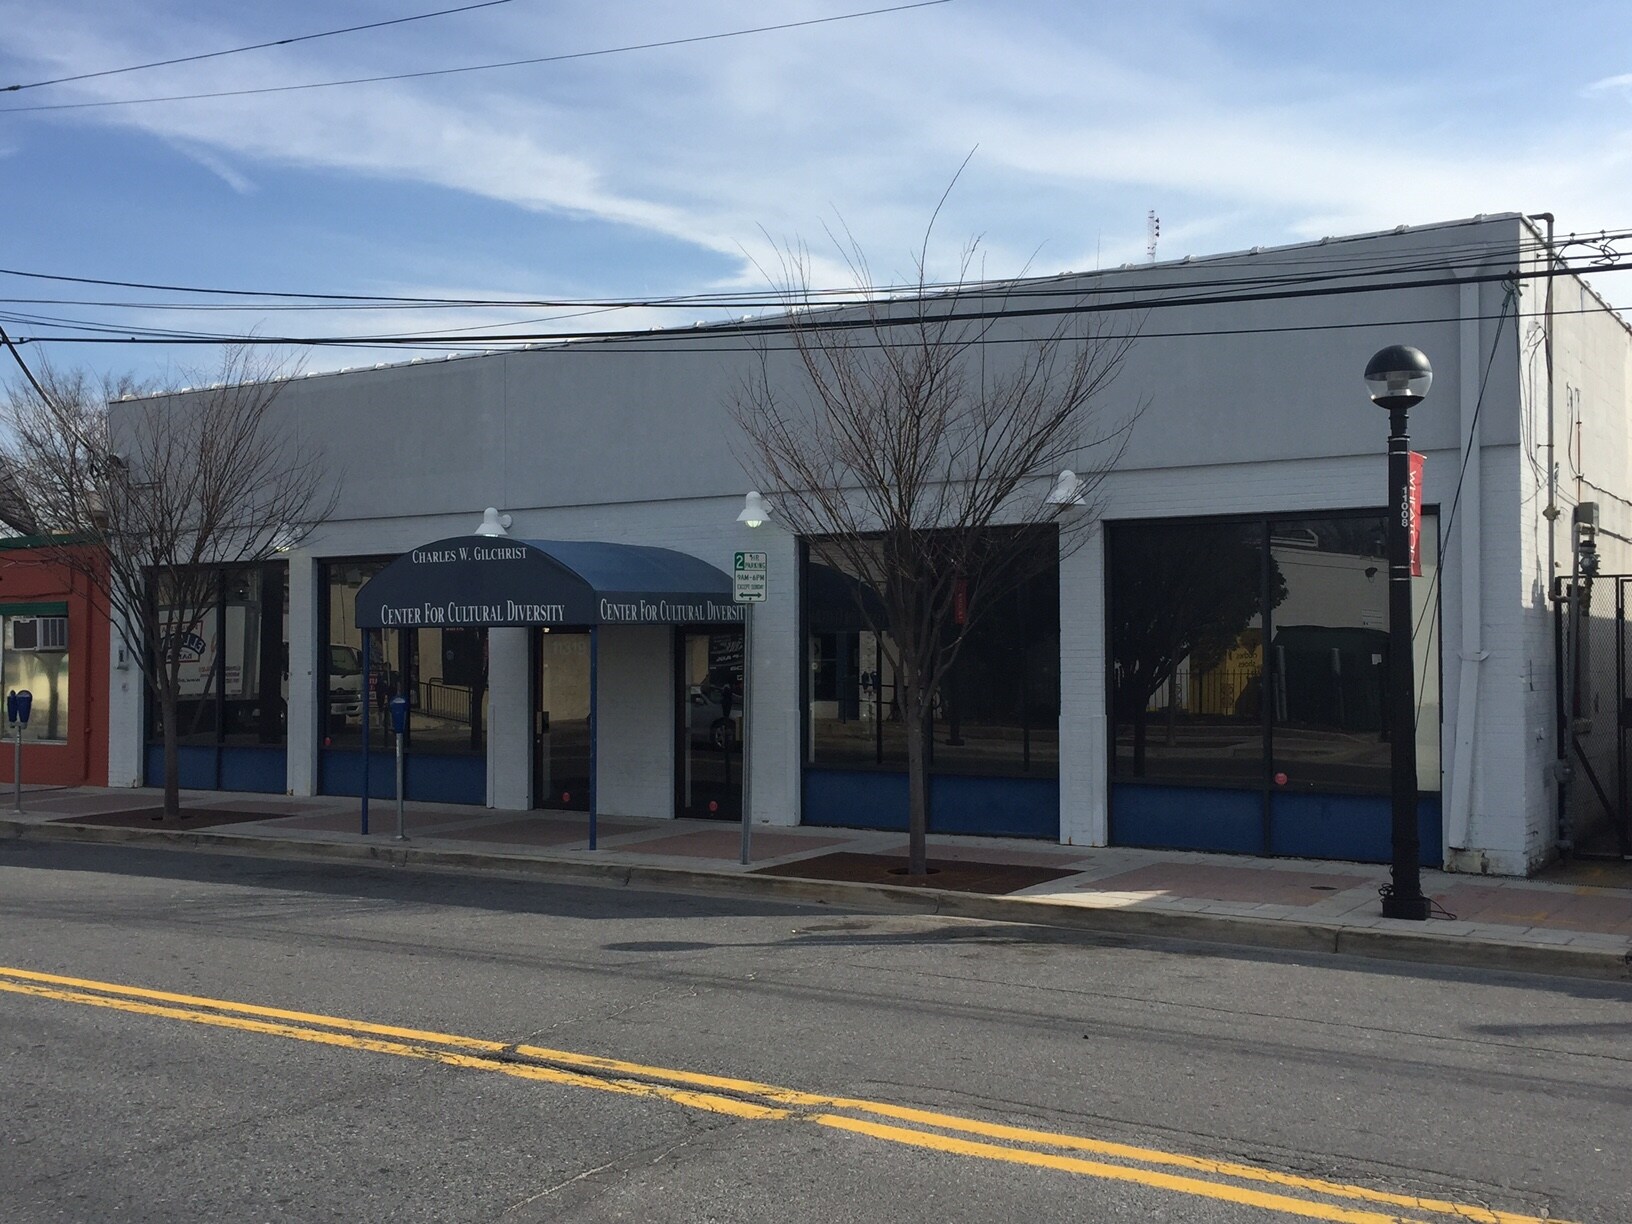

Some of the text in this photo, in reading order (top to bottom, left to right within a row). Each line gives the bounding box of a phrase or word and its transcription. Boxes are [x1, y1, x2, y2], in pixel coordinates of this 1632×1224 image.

[412, 546, 527, 564] CHARLES W. GILCHRIST
[736, 554, 744, 569] 2
[381, 600, 565, 625] CENTER FOR CULTURAL DIVERSITY
[600, 598, 744, 621] CENTER FOR CULTURAL DIVERSIT
